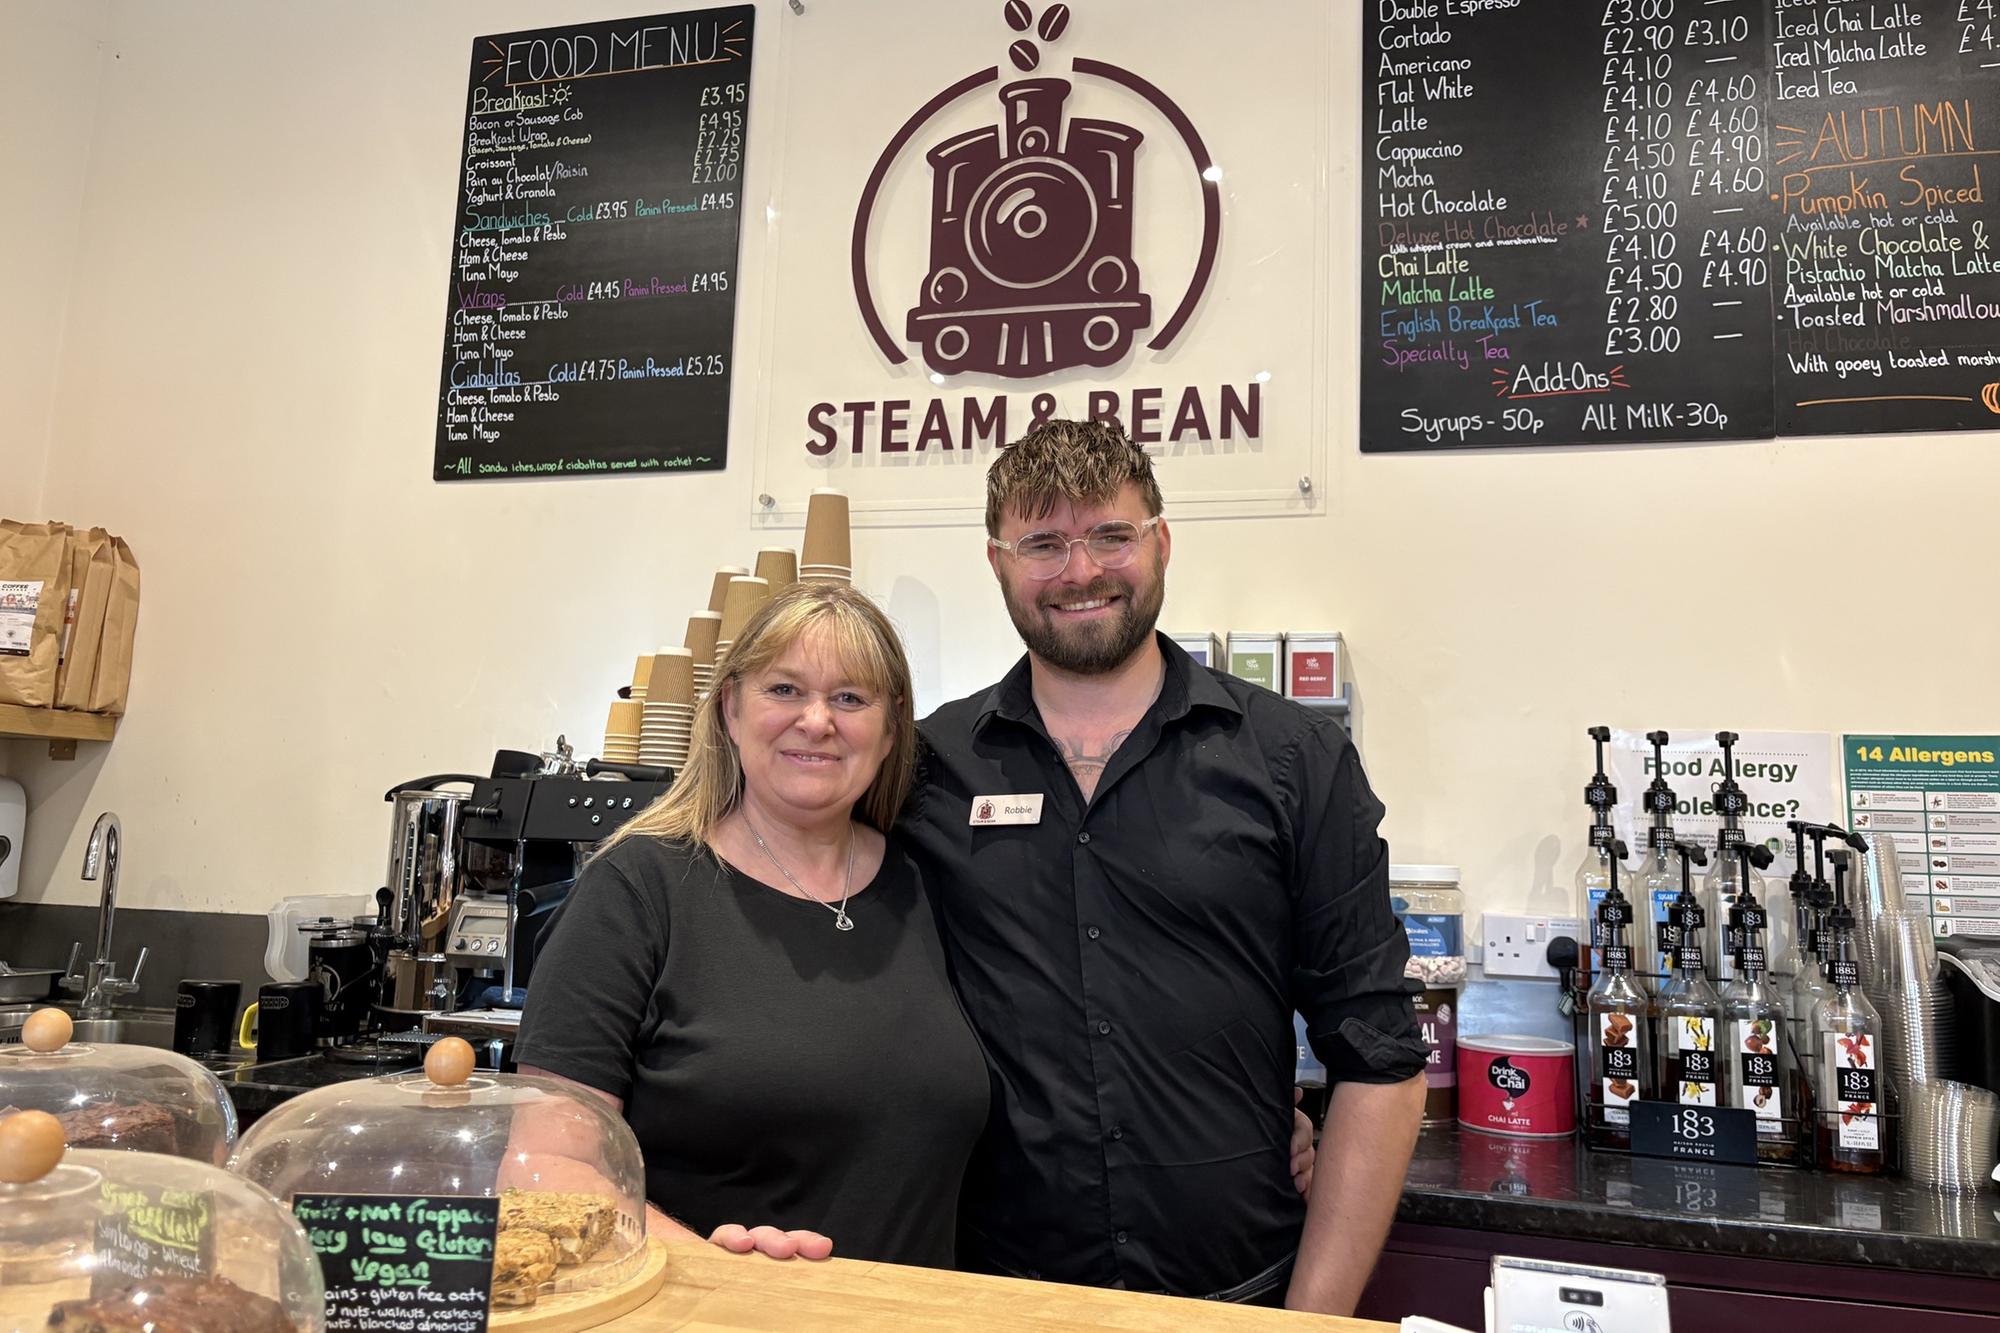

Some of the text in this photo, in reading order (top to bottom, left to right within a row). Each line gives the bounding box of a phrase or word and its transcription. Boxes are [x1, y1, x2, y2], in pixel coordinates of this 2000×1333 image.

[1379, 0, 1673, 26] Double Espresso £3.00
[1776, 2, 1922, 39] Iced Chai Latte
[1378, 15, 1748, 50] Cortado £3.10
[506, 22, 718, 84] FOOD MENU
[1774, 32, 1927, 68] Iced Matcha Latte
[1378, 54, 1471, 77] Americano
[472, 84, 549, 113] Breakfast
[1378, 75, 1473, 105] Flat White
[1776, 67, 1857, 100] Iced Tea
[469, 117, 500, 130] Bacon
[516, 113, 560, 127] Sausage
[563, 109, 583, 121] Cob
[701, 84, 745, 106] £3.95
[1378, 108, 1428, 134] Latte
[469, 112, 741, 146] Breakfast Wrap £4.95
[1809, 99, 1975, 162] AUTUMN
[466, 129, 740, 170] Croissant £2.25
[1377, 136, 1462, 167] Cappuccino
[466, 172, 487, 187] Pain
[491, 177, 502, 185] au
[694, 148, 739, 166] £2.75
[1379, 166, 1433, 189] Mocha
[466, 164, 737, 204] Yoghurt & Granola £2.00
[1783, 164, 1983, 219] Pumpkin Spiced
[464, 193, 734, 230] Sandwiches Cold £3.95 Panini Pressed £4.45
[1380, 190, 1507, 218] Hot Chocolate
[1380, 213, 1567, 247] Deluxe Hot Chocolate
[1787, 211, 1958, 233] Available hot or cold
[460, 226, 567, 249] Cheese, Tomato & Pesto
[1781, 221, 1989, 260] White Chocolate &
[459, 246, 528, 264] Ham & Cheese
[1378, 250, 1469, 278] Chai Latte
[1787, 250, 2000, 284] Pistachio Matcha Latte
[460, 264, 519, 282] Tuna Mayo
[458, 272, 728, 310] Wraps £4.45 £4.95
[1382, 276, 1494, 305] Matcha Latte
[1381, 295, 1677, 342] English Breakfast Tea £2.80
[1787, 303, 1866, 329] Toasted
[1382, 334, 1509, 370] Specialty Tea
[1787, 349, 1949, 379] With gooey toasted
[451, 355, 724, 387] Ciabattas £4.75 £5.25
[1512, 361, 1609, 393] Add-Ons
[805, 383, 1261, 456] STEAM & BEAN
[1582, 405, 1616, 430] Alt
[566, 455, 692, 470] ciabattas served with rocket
[1644, 757, 1798, 782] Food Alergy
[1857, 747, 1994, 766] 14 Allergens
[1492, 1066, 1516, 1076] Drink
[1496, 1075, 1525, 1089] Chai
[1488, 1115, 1530, 1126] CHAI LATTE
[1674, 1147, 1715, 1155] FRANCE
[351, 1256, 430, 1286] Vegan
[369, 1285, 486, 1305] gluten free oats
